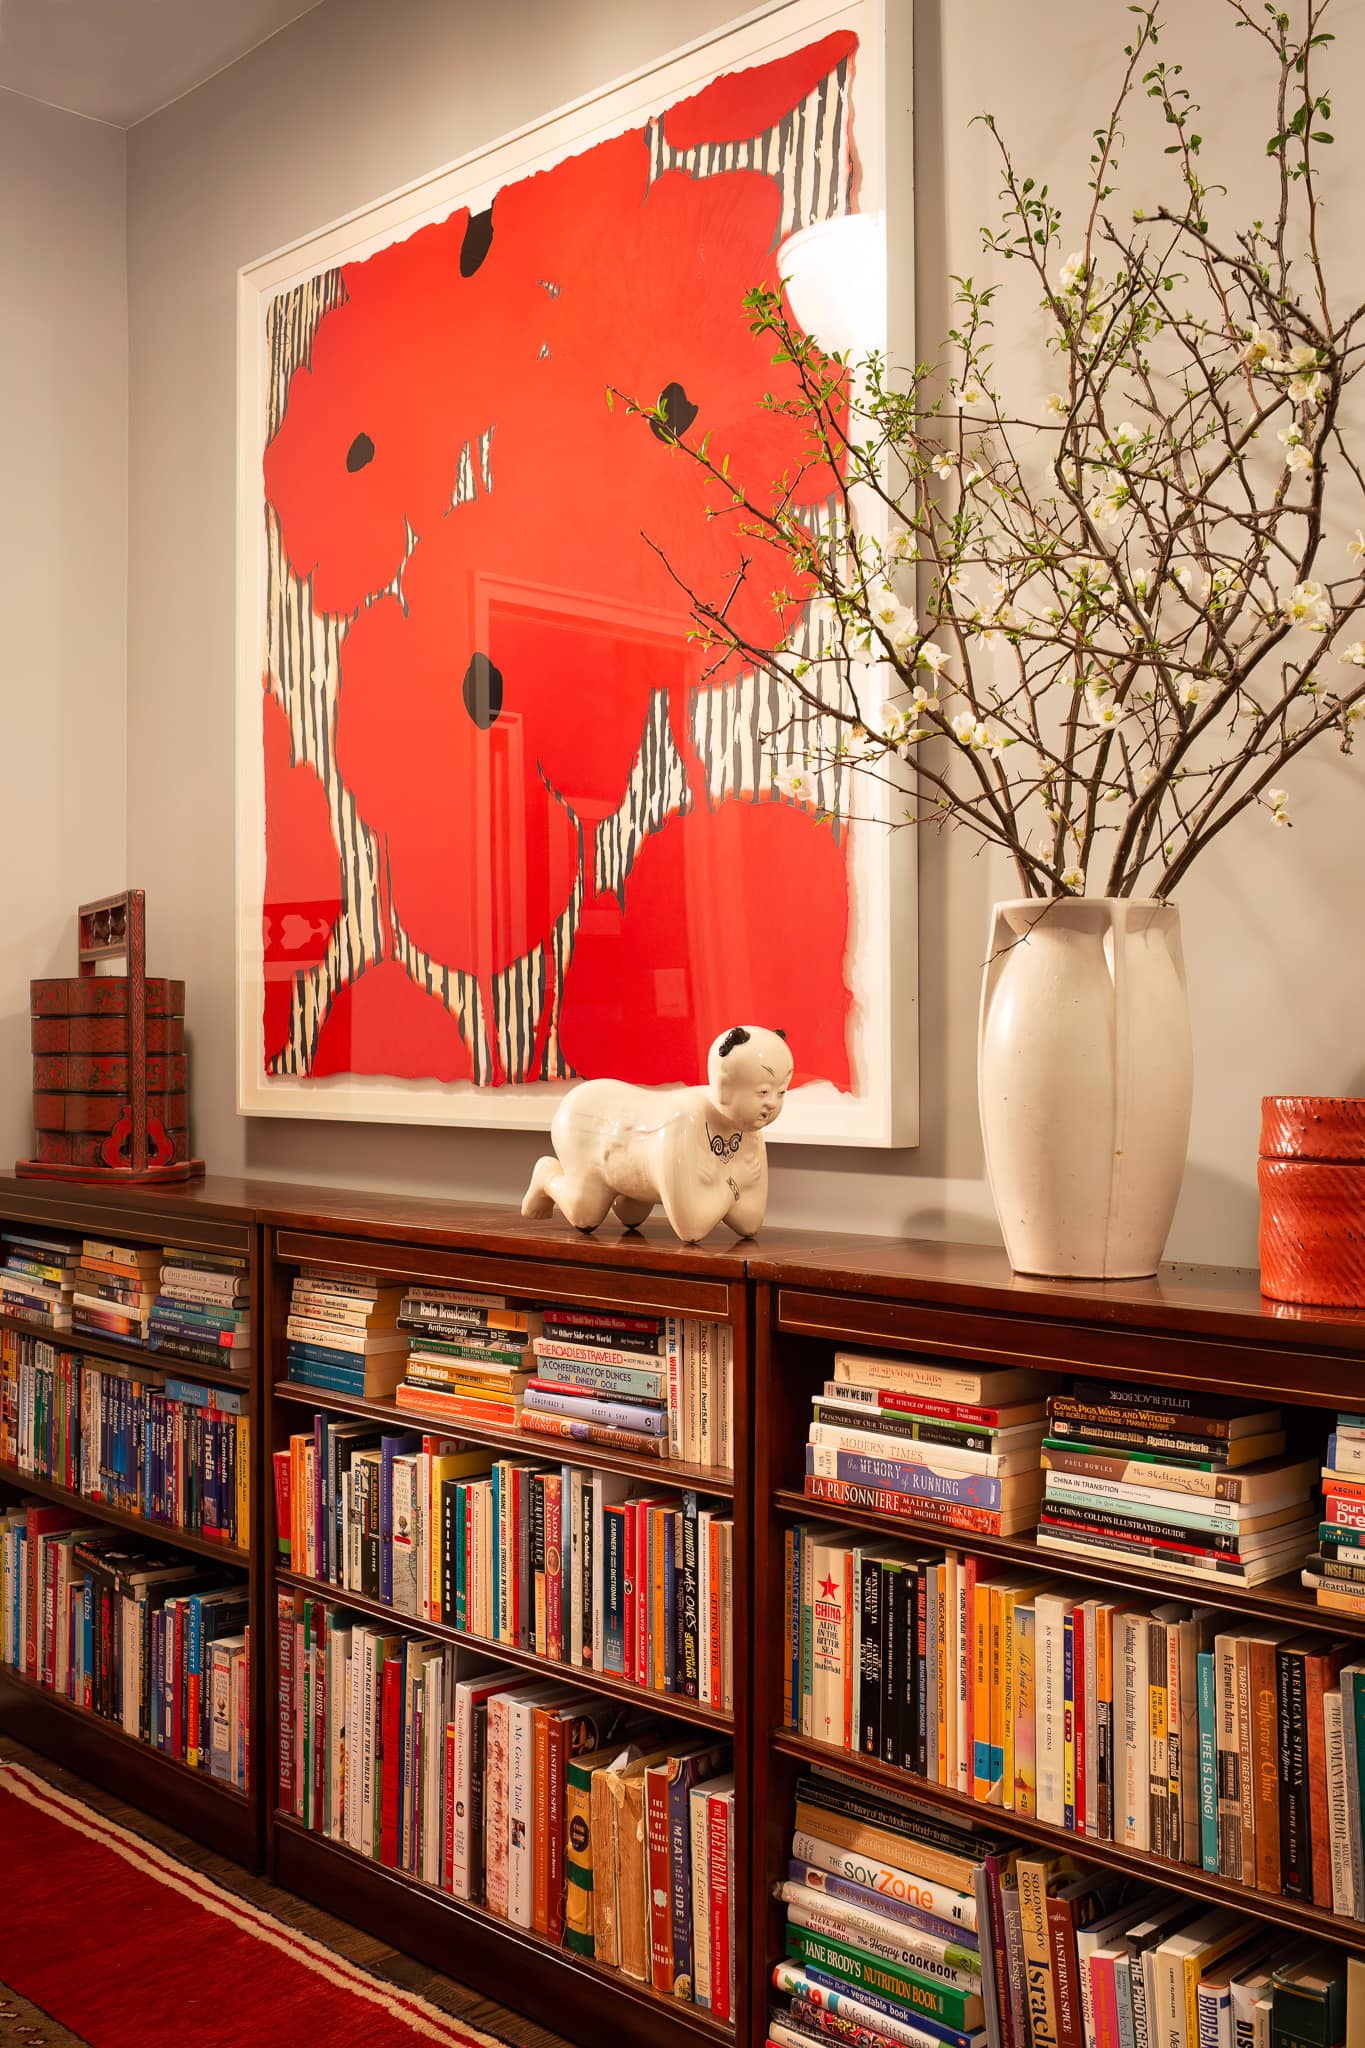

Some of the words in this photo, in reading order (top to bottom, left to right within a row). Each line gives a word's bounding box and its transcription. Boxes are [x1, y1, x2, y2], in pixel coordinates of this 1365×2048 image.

[420, 1302, 438, 1316] Radio
[440, 1304, 480, 1326] Broadcasting
[428, 1324, 468, 1336] Anthropology
[538, 1344, 552, 1354] THE
[552, 1346, 572, 1358] ROAD
[573, 1348, 588, 1360] LESS
[588, 1350, 624, 1364] TRAVELED
[548, 1361, 594, 1376] CONFEDERACY
[595, 1367, 604, 1376] OF
[606, 1370, 632, 1382] DUNCES
[670, 1384, 678, 1410] HOUSE
[836, 1386, 850, 1398] WHY
[850, 1389, 860, 1400] WE
[860, 1390, 872, 1402] BUY
[1110, 1391, 1132, 1400] BOOK
[1134, 1394, 1160, 1404] BLACK
[1161, 1396, 1190, 1408] LITTLE
[1122, 1412, 1138, 1420] AND
[1138, 1412, 1176, 1424] WITCHES
[840, 1436, 885, 1454] MODERN
[890, 1447, 924, 1462] TIMES
[1080, 1425, 1103, 1436] Death
[1104, 1429, 1114, 1438] on
[1114, 1428, 1126, 1439] the
[1146, 1435, 1176, 1448] Agatha
[1176, 1438, 1208, 1454] Christie
[205, 1434, 214, 1480] India
[848, 1456, 858, 1470] the
[860, 1458, 901, 1480] MEMORY
[913, 1475, 960, 1496] RUNNING
[1053, 1476, 1072, 1486] CHINA
[1073, 1480, 1080, 1488] IN
[1082, 1480, 1119, 1494] TRANSITION
[1134, 1467, 1144, 1478] the
[1147, 1468, 1192, 1490] Sheltering
[1194, 1478, 1210, 1492] Sky
[812, 1479, 824, 1496] LA
[827, 1482, 900, 1512] PRISONNIERE
[1336, 1501, 1360, 1512] Your
[552, 1505, 560, 1542] NAOMI
[1046, 1504, 1058, 1513] ALL
[1059, 1506, 1084, 1518] CHINA:
[1084, 1511, 1112, 1524] COLLINS
[1113, 1516, 1160, 1534] ILLUSTRATED
[1162, 1526, 1186, 1538] GUIDE
[684, 1520, 695, 1568] RIVINGTON
[684, 1568, 696, 1594] WAS
[918, 1578, 926, 1590] THE
[1324, 1562, 1352, 1579] INSIDE
[1318, 1579, 1365, 1596] Heartland
[84, 1588, 92, 1620] Cuba
[684, 1595, 696, 1632] OURS
[816, 1603, 841, 1620] CHINA
[918, 1594, 926, 1618] MALAY
[818, 1621, 838, 1632] ALIVE
[826, 1630, 838, 1641] THE
[918, 1621, 926, 1655] DILEMMA
[280, 1634, 293, 1669] four
[712, 1637, 719, 1648] TO
[816, 1635, 840, 1648] BITTER
[822, 1645, 834, 1656] SEA
[1224, 1663, 1234, 1698] Farewell
[1292, 1660, 1301, 1730] AMERICAN
[1224, 1701, 1234, 1709] to
[1240, 1708, 1248, 1720] AT
[1256, 1690, 1274, 1746] Emperor
[1332, 1707, 1341, 1727] THE
[280, 1676, 293, 1777] ingredients
[366, 1728, 370, 1738] OF
[514, 1728, 522, 1742] My
[1224, 1710, 1234, 1734] Arms
[1168, 1736, 1178, 1777] Fitzgerald
[1202, 1733, 1212, 1759] LIFE
[1260, 1748, 1270, 1760] of
[1330, 1730, 1343, 1778] WOMAN
[514, 1746, 522, 1780] Greek
[1203, 1762, 1212, 1774] IS
[1242, 1754, 1250, 1782] TIGER
[1293, 1736, 1302, 1786] SPHINX
[1261, 1762, 1278, 1802] China
[714, 1804, 722, 1818] THE
[1204, 1776, 1213, 1820] LONG!
[1243, 1784, 1252, 1828] SANCTUM
[1332, 1780, 1347, 1840] WARRIOR
[674, 1826, 684, 1864] MEAT
[696, 1822, 705, 1862] Fistful
[712, 1818, 727, 1893] VEGETARIAN
[696, 1877, 706, 1918] Lentils
[829, 1856, 842, 1868] THE
[844, 1860, 878, 1887] SOY
[878, 1869, 934, 1910] Zone
[1022, 1872, 1031, 1906] COOK
[676, 1885, 684, 1918] SIDE
[1031, 1873, 1046, 1950] SOLOMONOV
[869, 1937, 900, 1961] Happy
[902, 1951, 958, 1982] COOKBOOK
[1056, 1930, 1072, 1999] MASTERING
[805, 1939, 826, 1963] JANE
[827, 1946, 861, 1978] BRODY'S
[864, 1966, 912, 2000] NUTRITION
[912, 1986, 937, 2010] BOOK
[851, 1989, 888, 2012] vegetable
[890, 2004, 909, 2022] book
[1062, 2001, 1072, 2032] SPICE
[844, 2004, 876, 2028] Mark
[880, 2018, 930, 2048] Bittman
